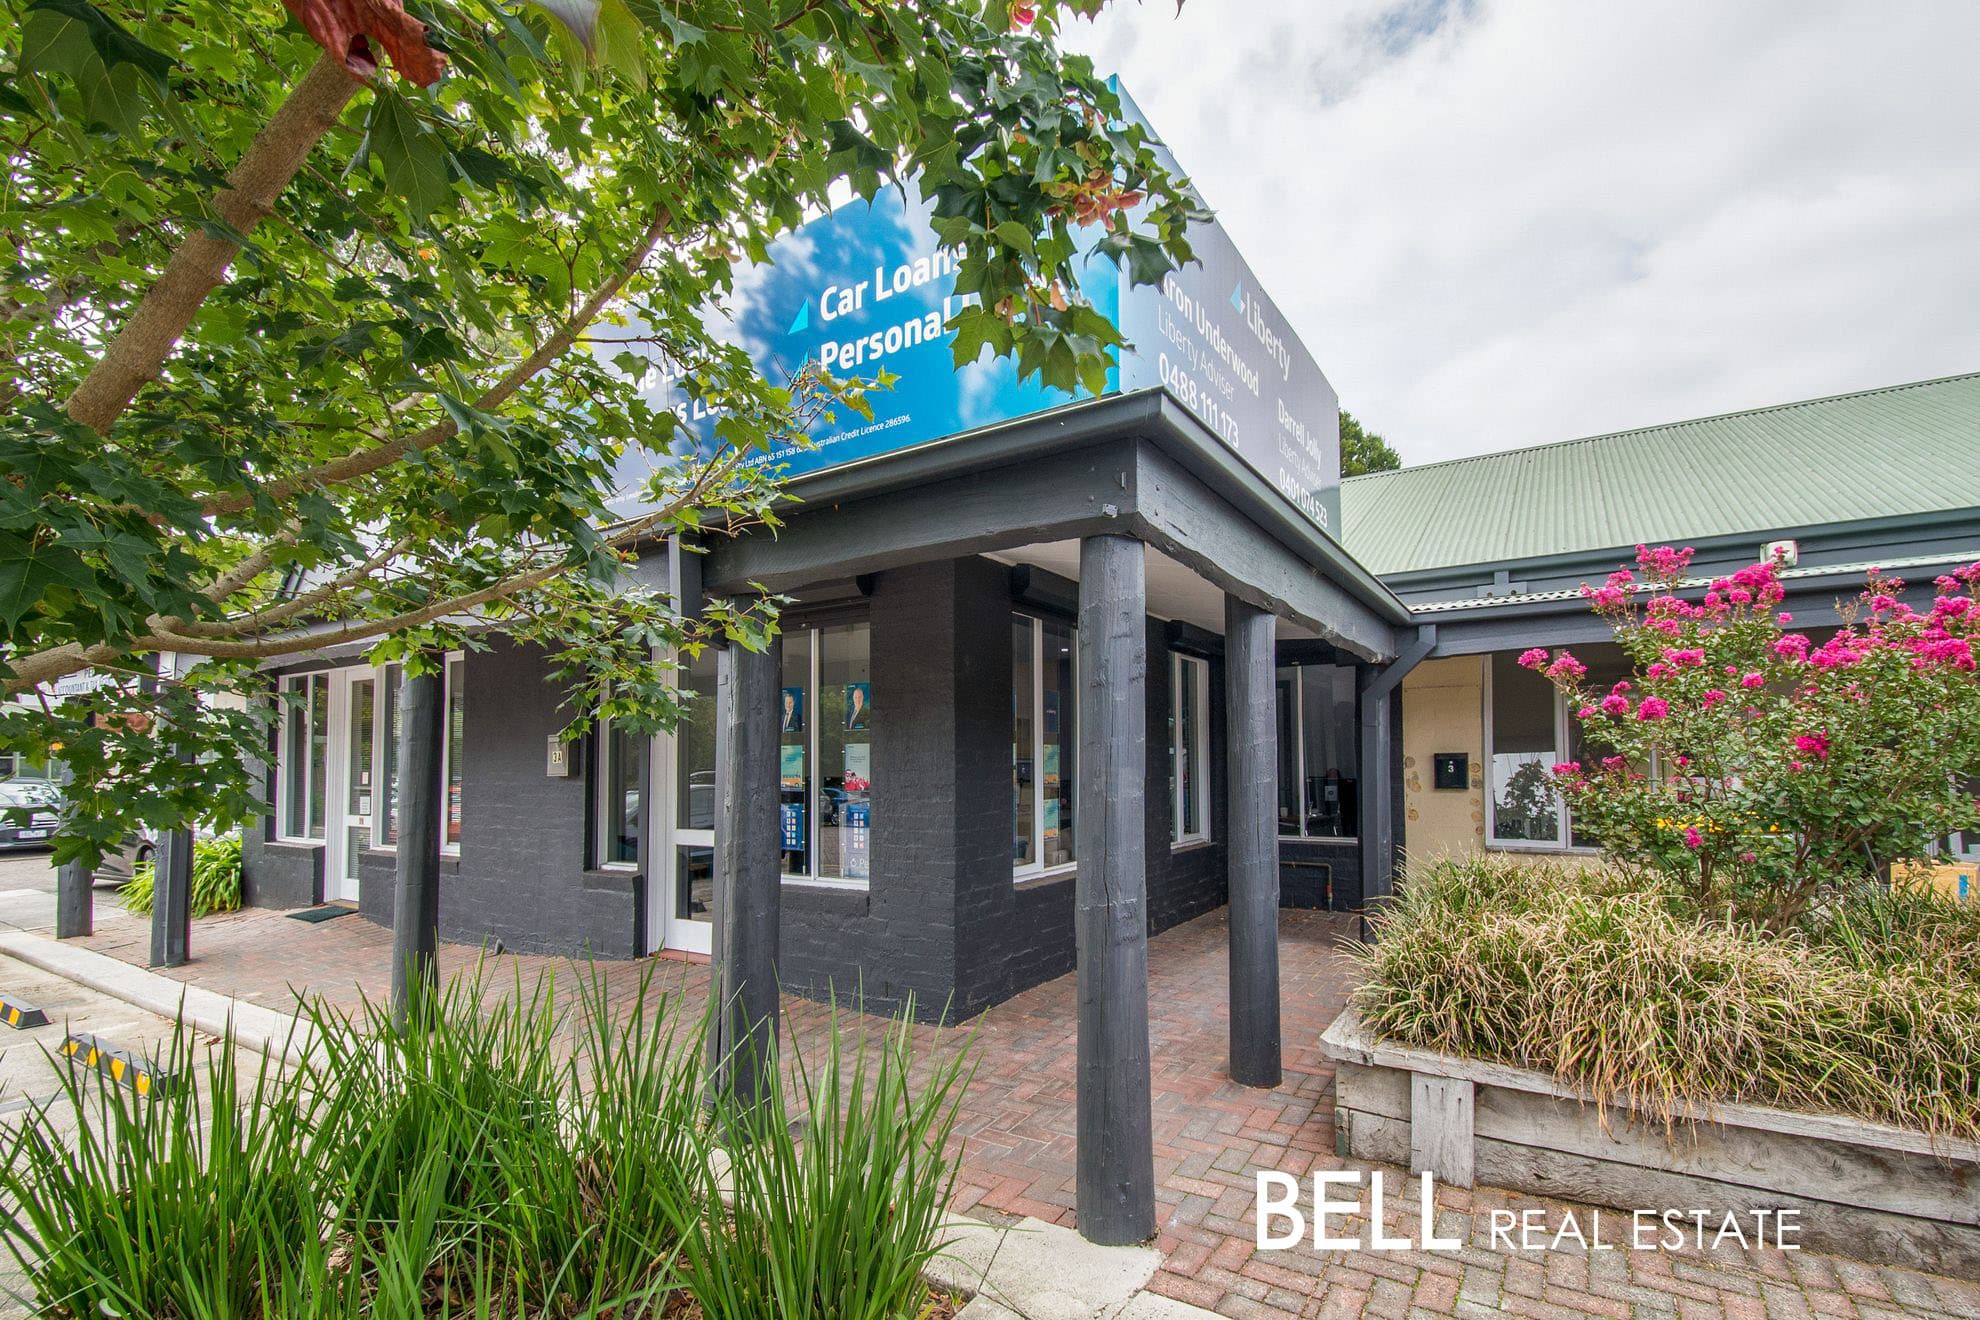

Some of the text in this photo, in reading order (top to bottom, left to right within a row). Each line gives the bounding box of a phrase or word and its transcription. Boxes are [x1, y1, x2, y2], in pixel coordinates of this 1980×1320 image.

[820, 281, 868, 321] Car
[819, 298, 959, 371] Personal
[1158, 304, 1235, 402] Liberty Adviser
[1196, 302, 1259, 398] Underwood
[1246, 291, 1291, 381] Liberty
[1159, 352, 1239, 449] 0488 111 173
[1278, 398, 1305, 447] Darrell
[754, 454, 767, 466] ABN
[768, 452, 776, 462] 65
[776, 450, 785, 459] 151
[841, 429, 859, 442] Credit
[861, 422, 884, 436] Licence
[1278, 432, 1301, 474] Liberty
[1279, 467, 1300, 503] 0401
[1448, 765, 1455, 773] 3
